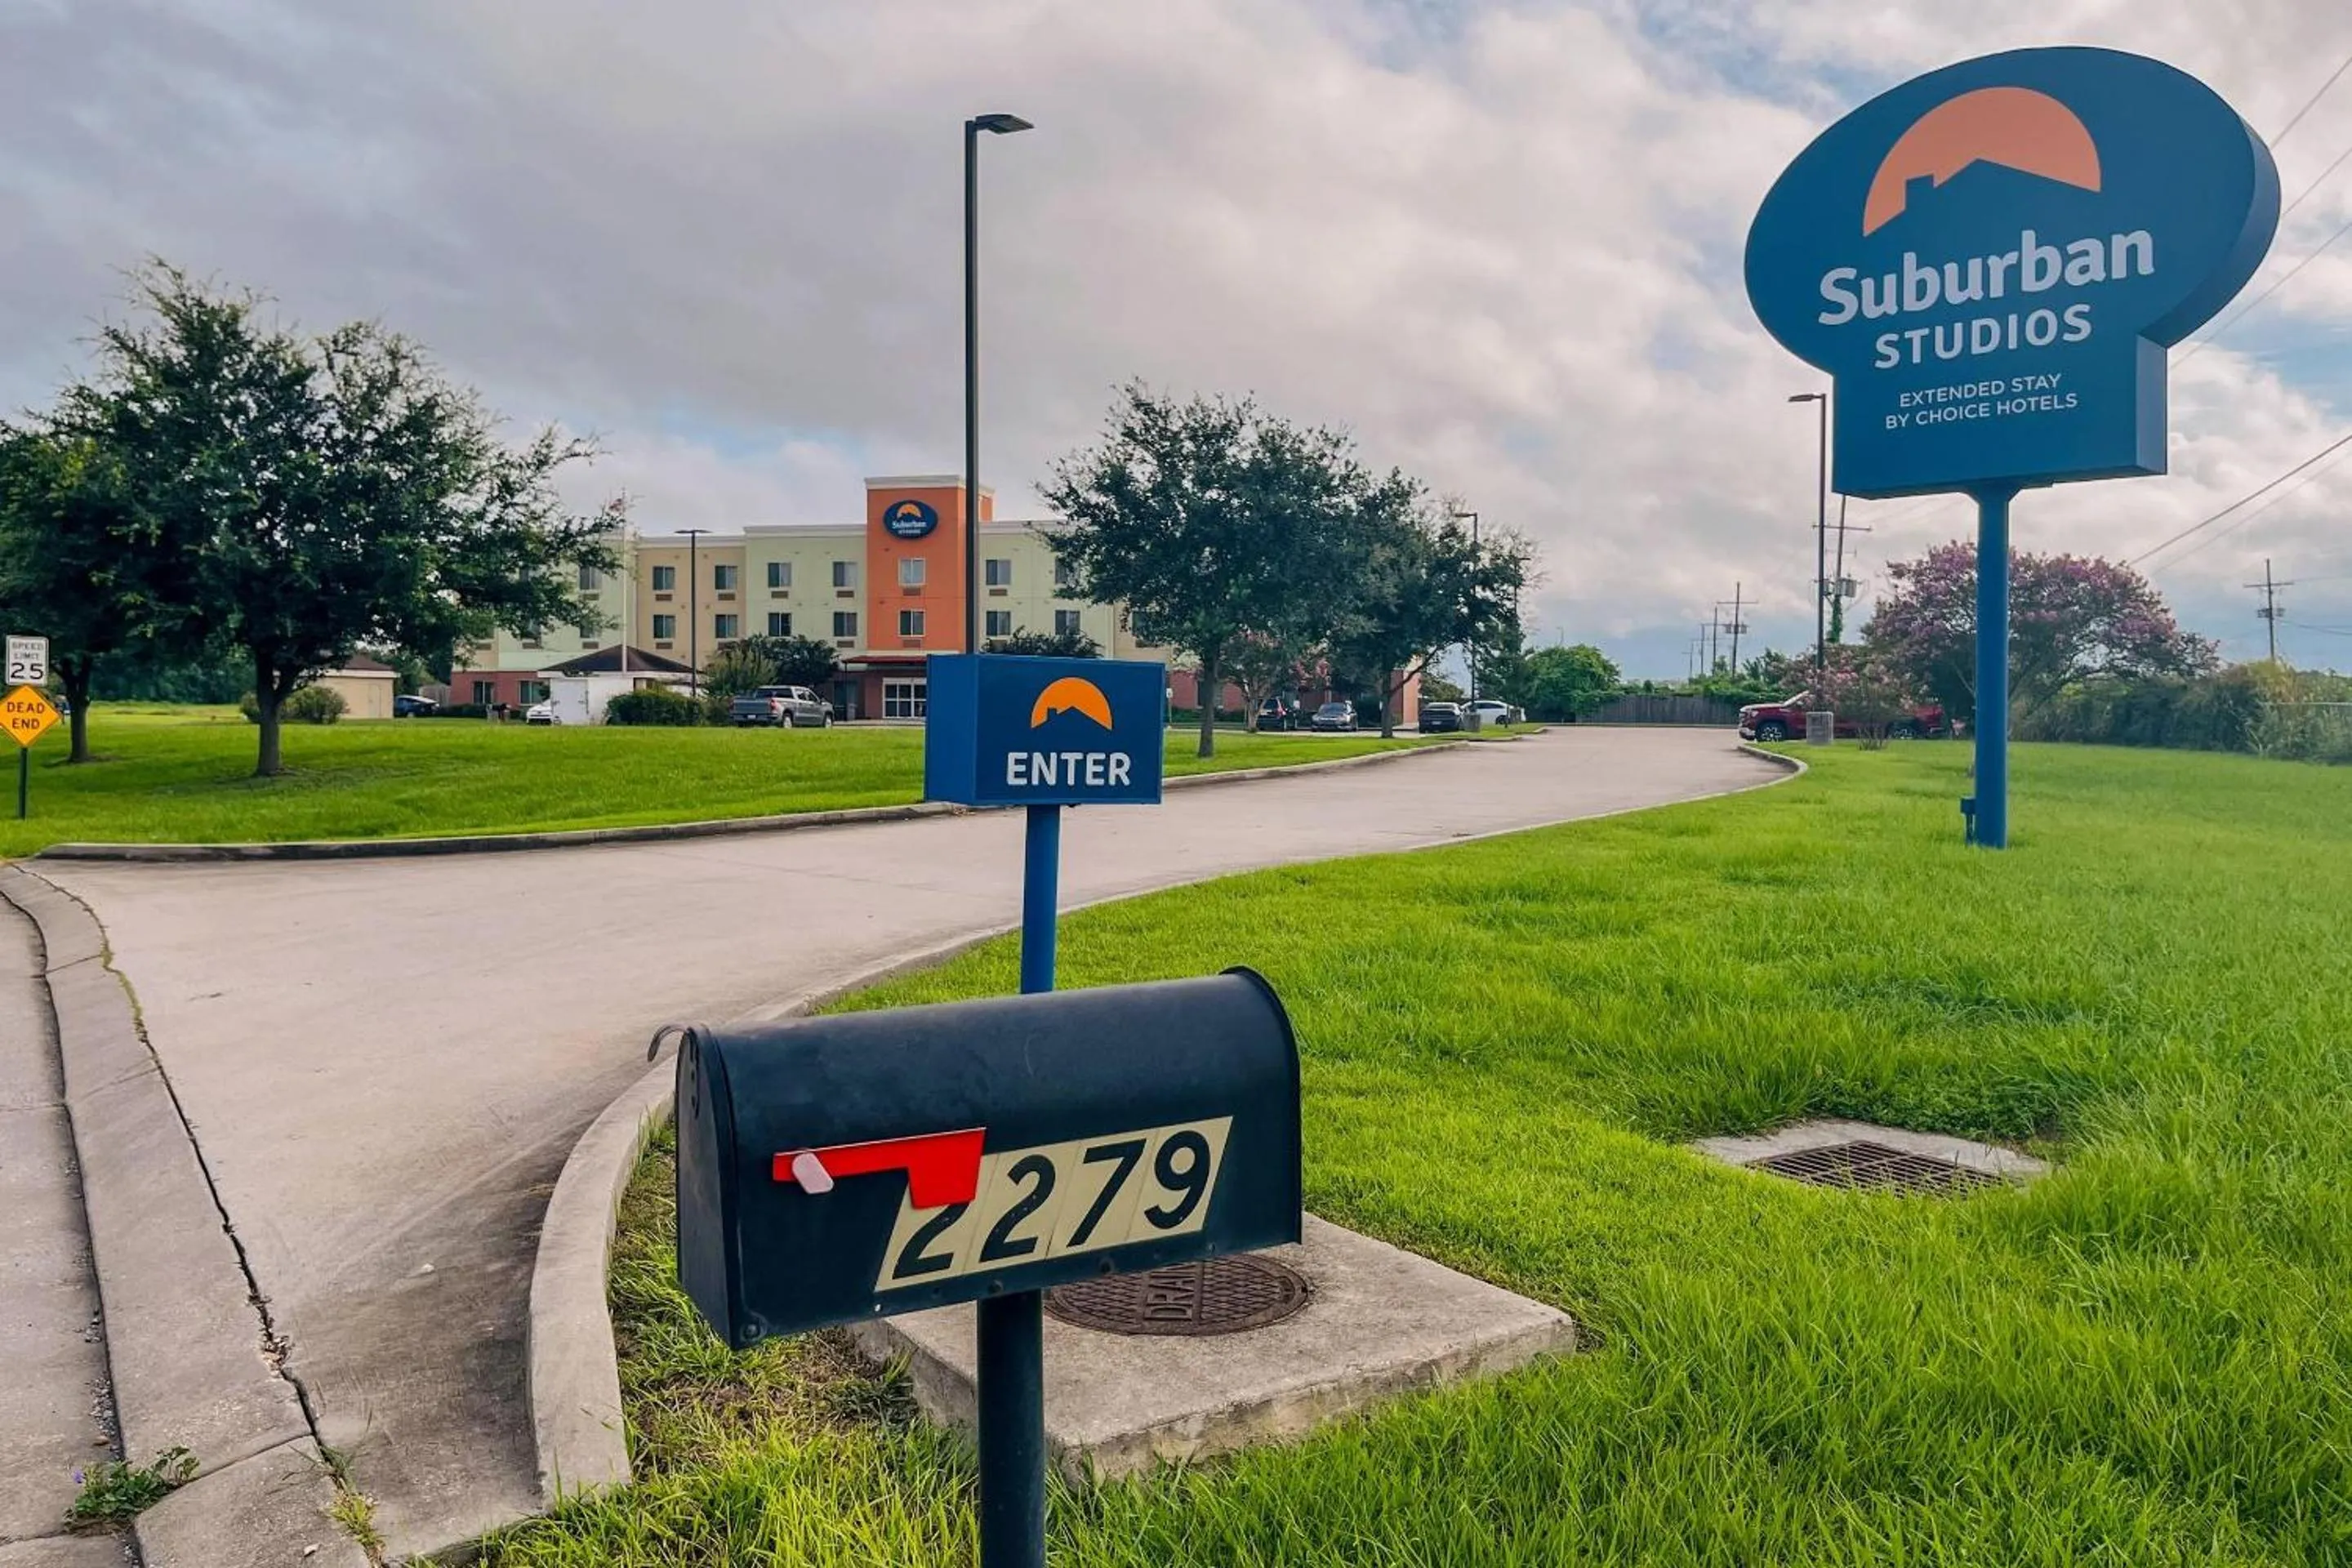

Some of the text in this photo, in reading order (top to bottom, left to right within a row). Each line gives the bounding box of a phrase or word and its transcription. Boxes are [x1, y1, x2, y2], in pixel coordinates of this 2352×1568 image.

[1818, 229, 2155, 326] Suburban
[1874, 304, 2092, 370] STUDIOS
[1900, 373, 2062, 408] EXTENDED STAY
[1885, 393, 2078, 430] BY CHOICE HOTELS
[11, 641, 44, 650] SPEED
[11, 662, 44, 679] 25
[7, 702, 45, 714] DEAD
[11, 718, 40, 729] END
[1005, 751, 1132, 786] ENTER
